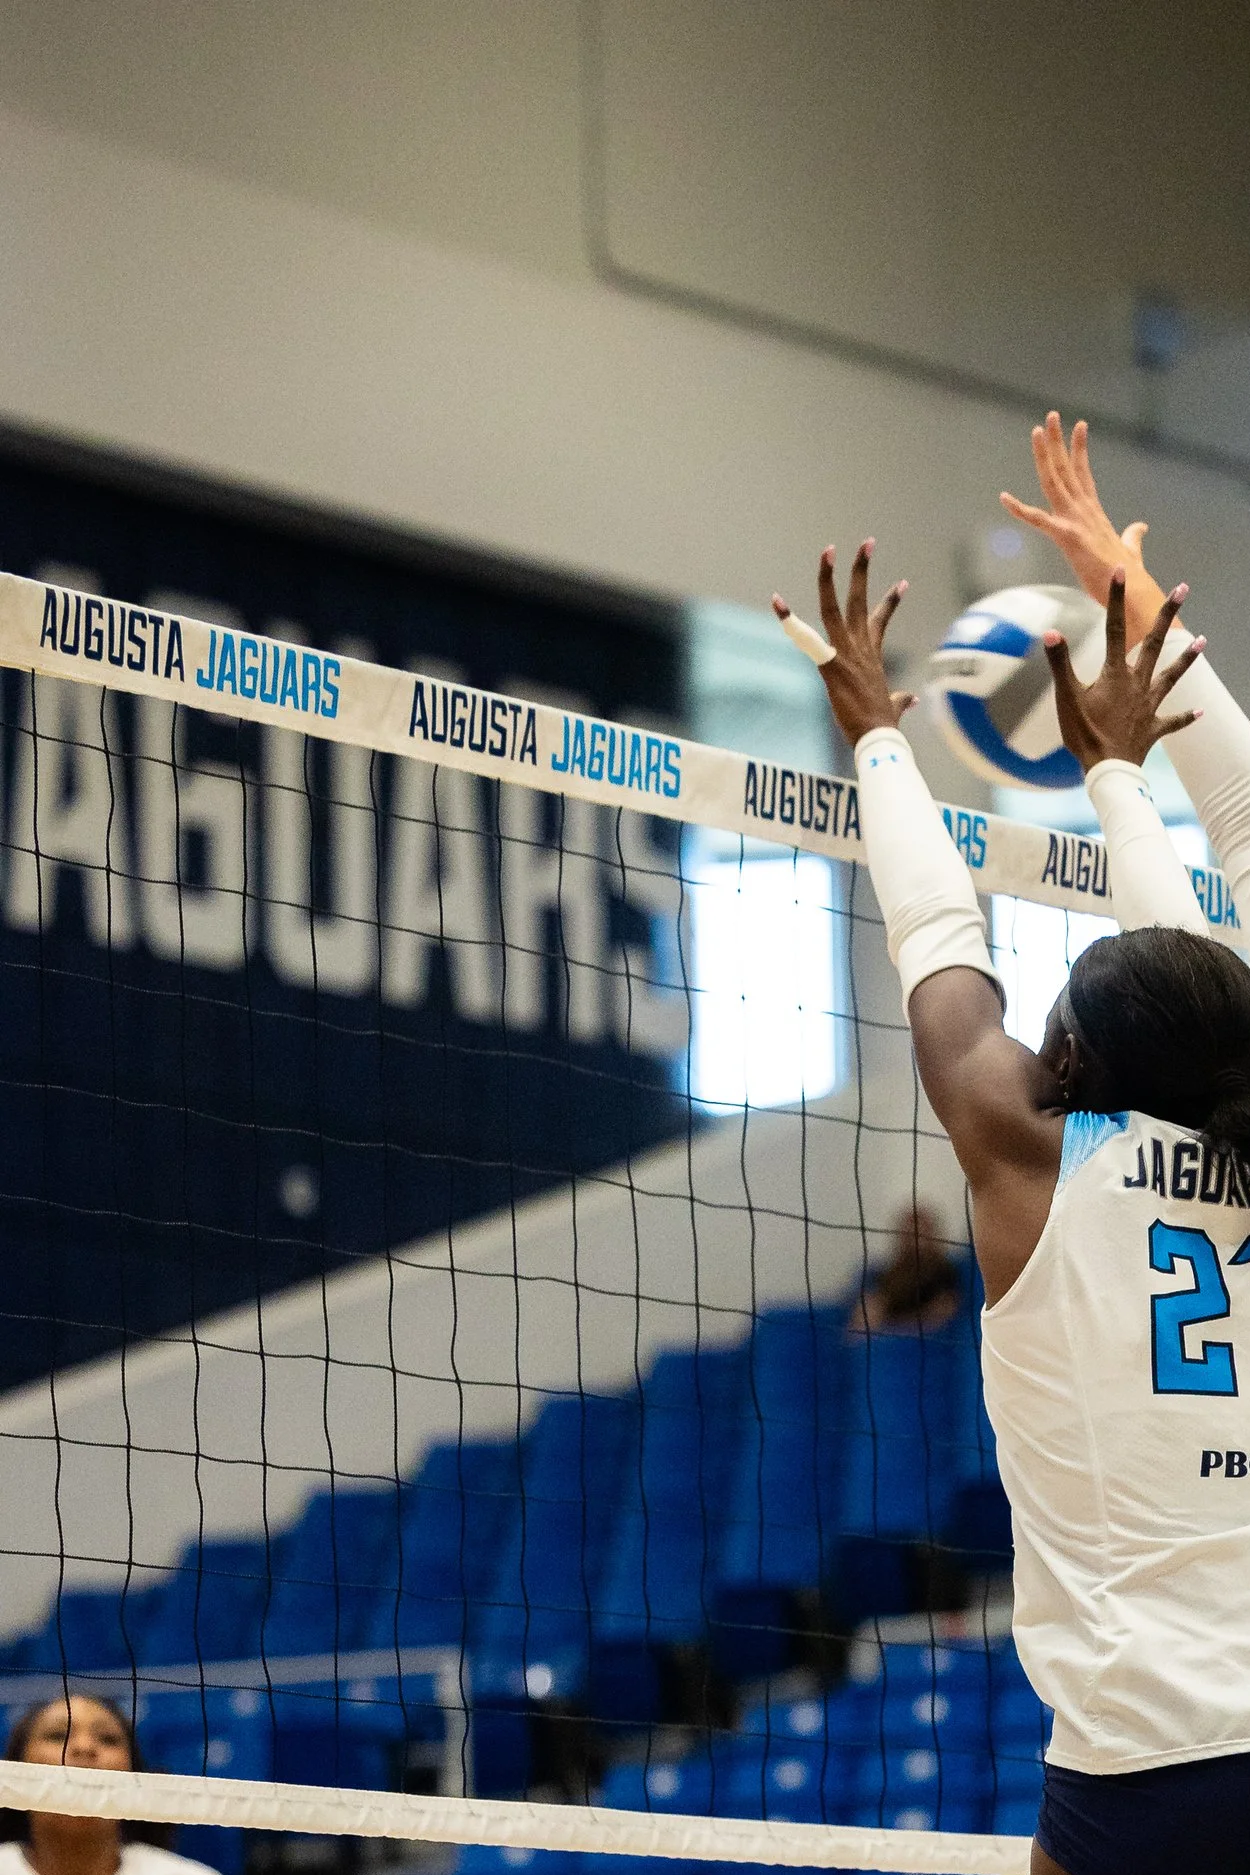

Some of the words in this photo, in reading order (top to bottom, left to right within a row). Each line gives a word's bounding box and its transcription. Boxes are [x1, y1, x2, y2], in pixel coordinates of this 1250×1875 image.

[40, 587, 185, 682] AUGUSTA
[196, 629, 341, 719] JAGUARS
[409, 680, 537, 766] AUGUSTA
[551, 715, 681, 798] JAGUARS
[744, 761, 861, 840] AUGUSTA
[1042, 833, 1112, 898] AUGU
